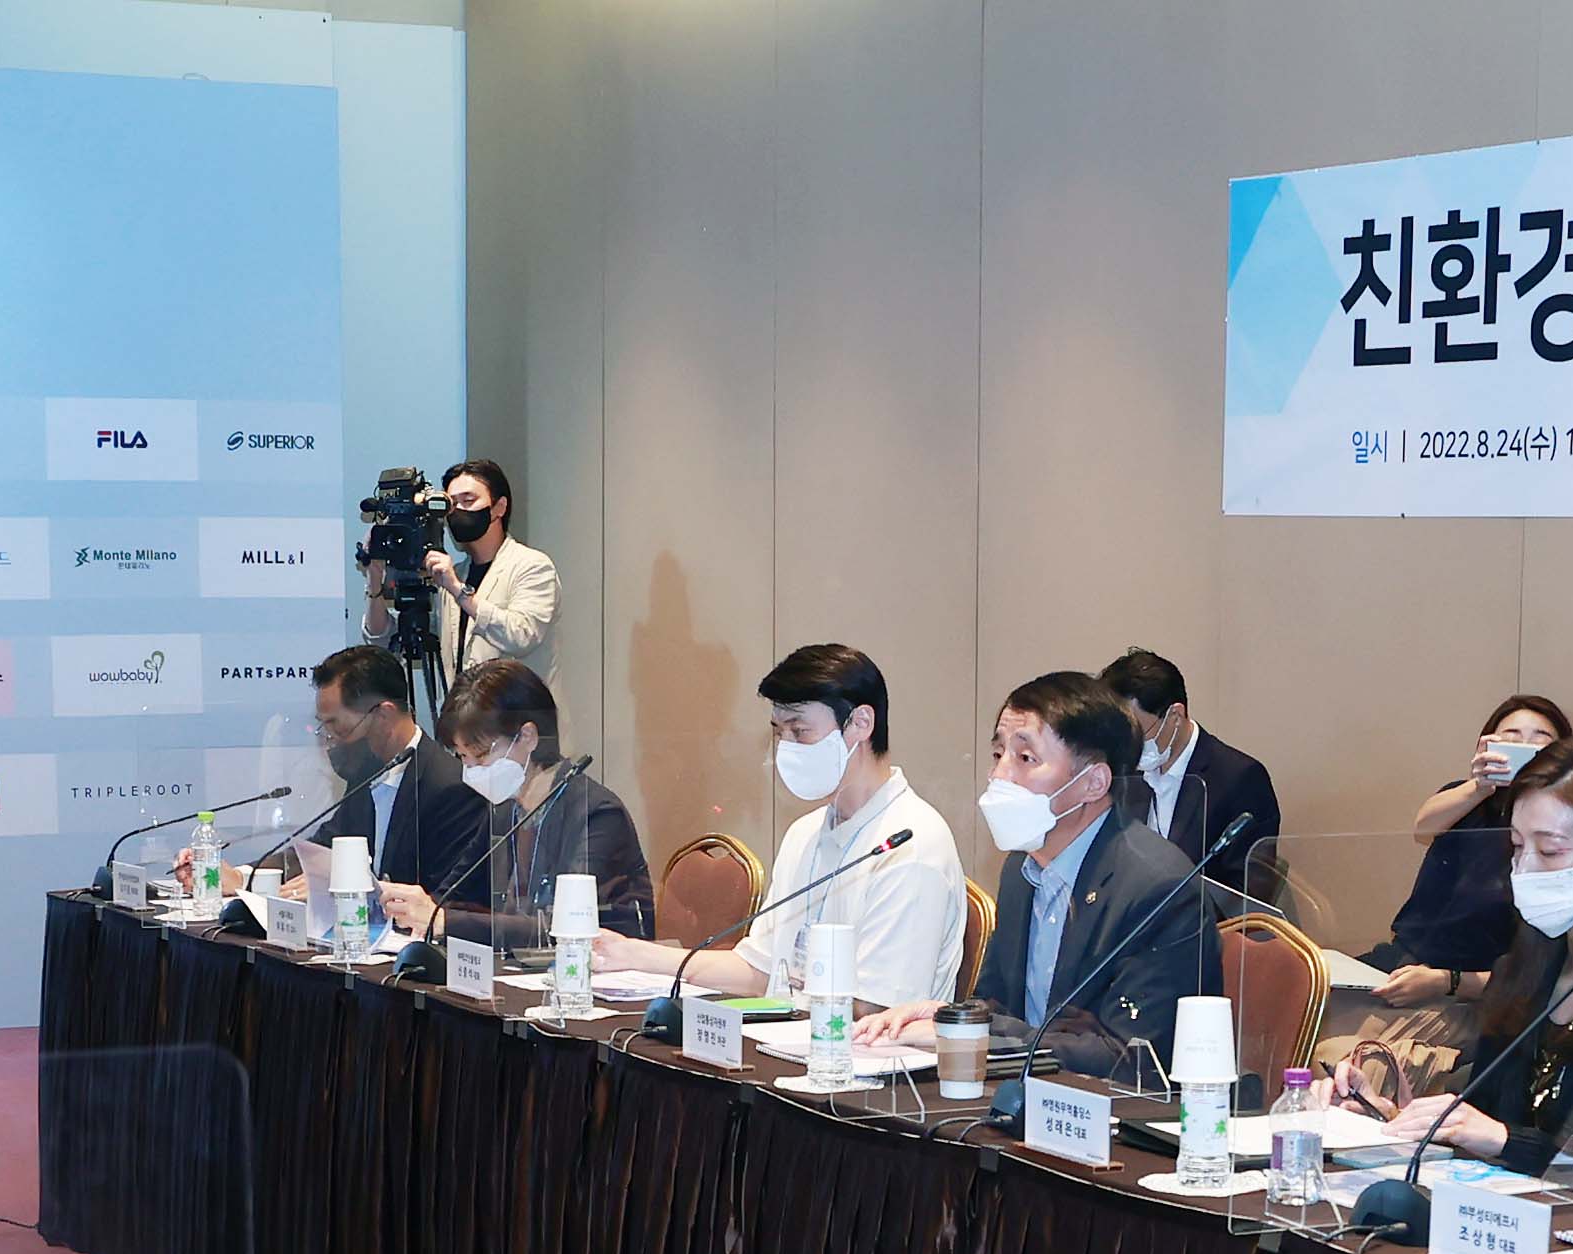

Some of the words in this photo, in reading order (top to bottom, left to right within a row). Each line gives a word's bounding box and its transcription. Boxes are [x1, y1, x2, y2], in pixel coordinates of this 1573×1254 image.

[96, 430, 148, 449] FILA
[248, 433, 315, 451] SUPERIOR
[1351, 429, 1389, 464] 일시
[1419, 426, 1557, 462] 2022.8.24(수)
[93, 550, 132, 561] Monte
[136, 550, 177, 561] Milano
[242, 550, 285, 565] MILL
[89, 667, 154, 684] wowbaby
[71, 783, 194, 799] TRIPLEROOT
